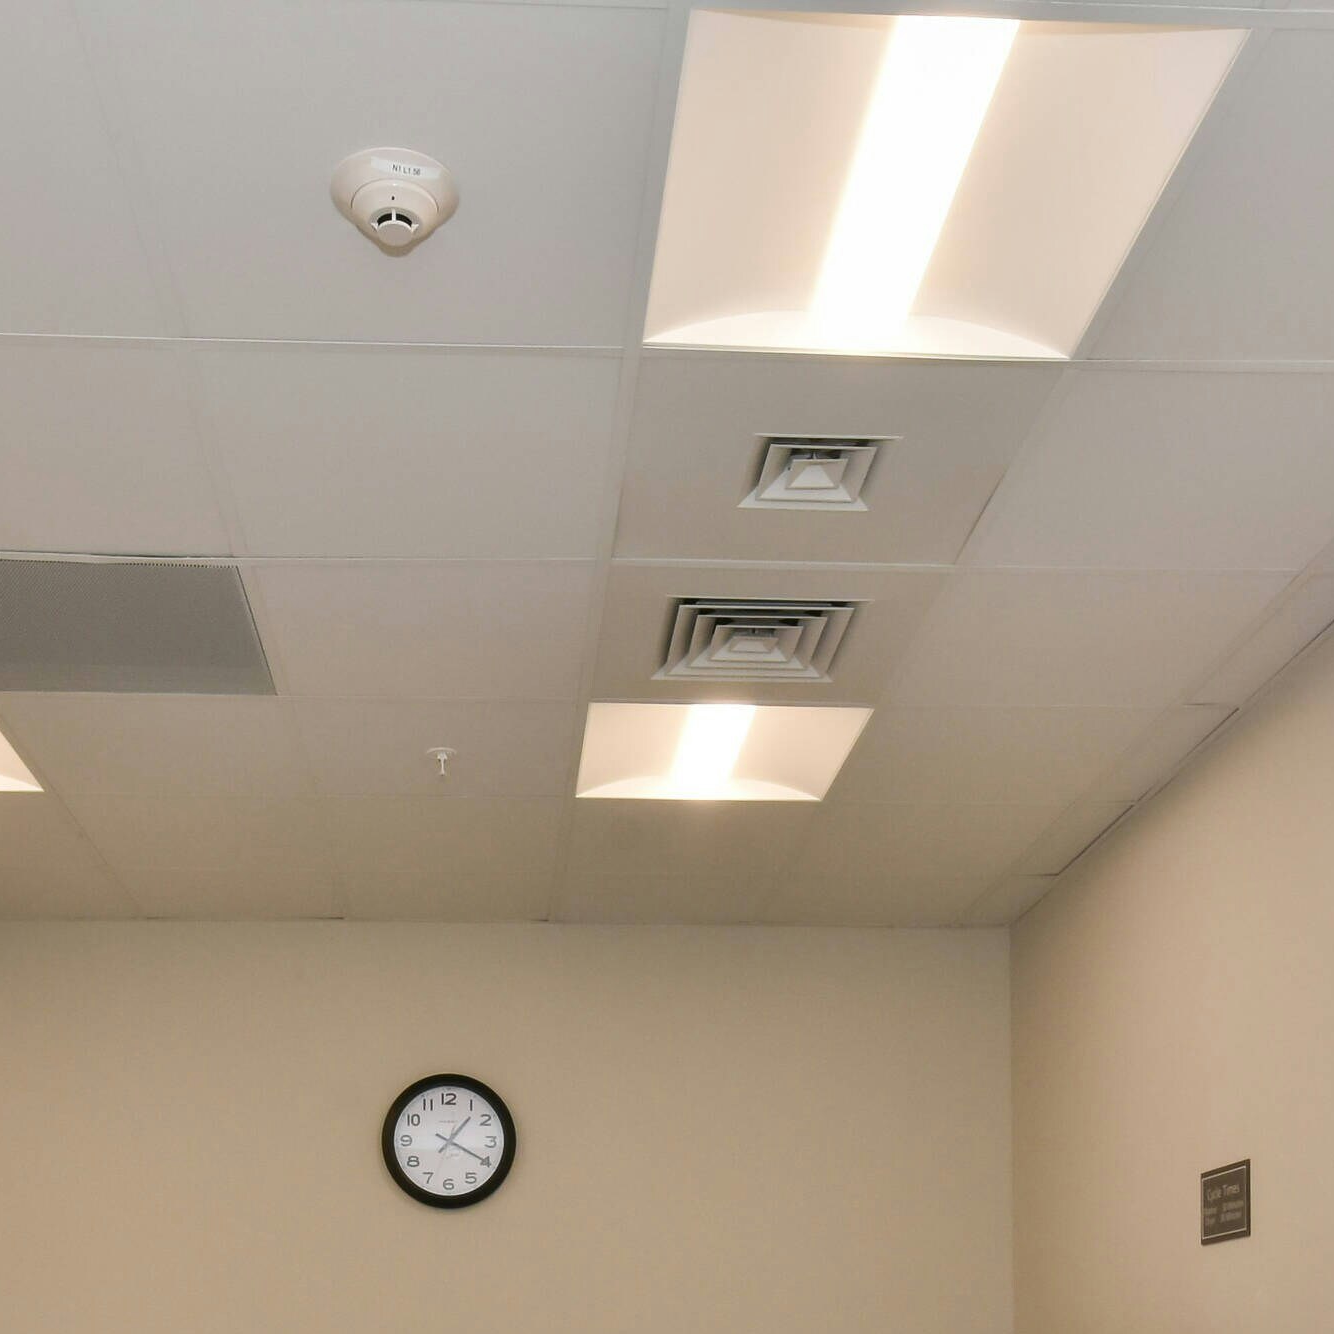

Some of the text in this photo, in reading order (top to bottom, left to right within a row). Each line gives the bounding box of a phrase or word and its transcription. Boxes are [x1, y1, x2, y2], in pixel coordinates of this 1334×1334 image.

[422, 1099, 434, 1111] 11
[441, 1093, 457, 1105] 12
[407, 1114, 421, 1126] 10
[479, 1114, 492, 1126] 2
[400, 1135, 413, 1147] 9
[484, 1136, 497, 1148] 3
[407, 1156, 420, 1167] 8
[480, 1156, 492, 1168] 4
[422, 1172, 434, 1184] 7
[465, 1172, 477, 1184] 5
[442, 1179, 455, 1190] 6
